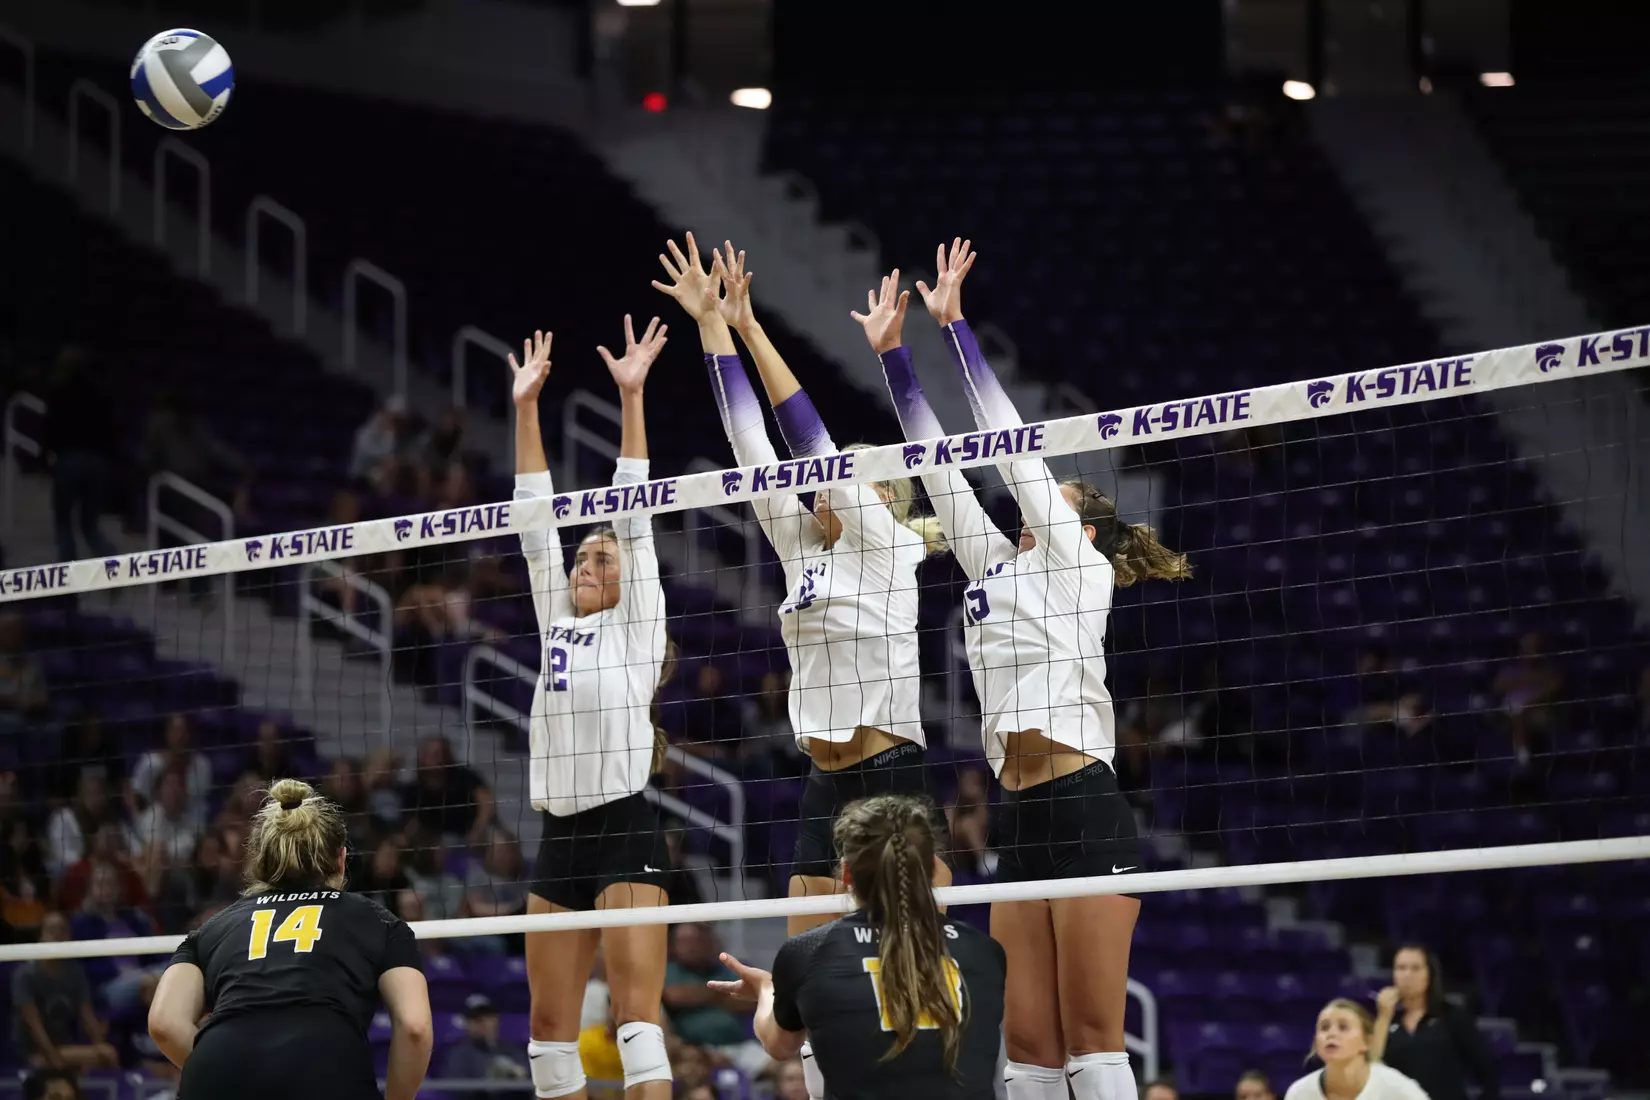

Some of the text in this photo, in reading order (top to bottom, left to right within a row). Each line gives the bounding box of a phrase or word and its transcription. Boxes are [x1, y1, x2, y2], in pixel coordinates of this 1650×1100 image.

[128, 546, 208, 579] K-STATE
[269, 526, 354, 560] K-STATE
[419, 504, 511, 539] K-STATE
[580, 479, 678, 517] K-STATE
[751, 452, 856, 493] K-STATE
[934, 424, 1045, 466] K-STATE
[1132, 391, 1252, 436] K-STATE
[1345, 357, 1474, 404] K-STATE
[873, 744, 918, 768] NIKE PRO
[256, 891, 341, 905] WILDCATS
[248, 905, 324, 961] 14
